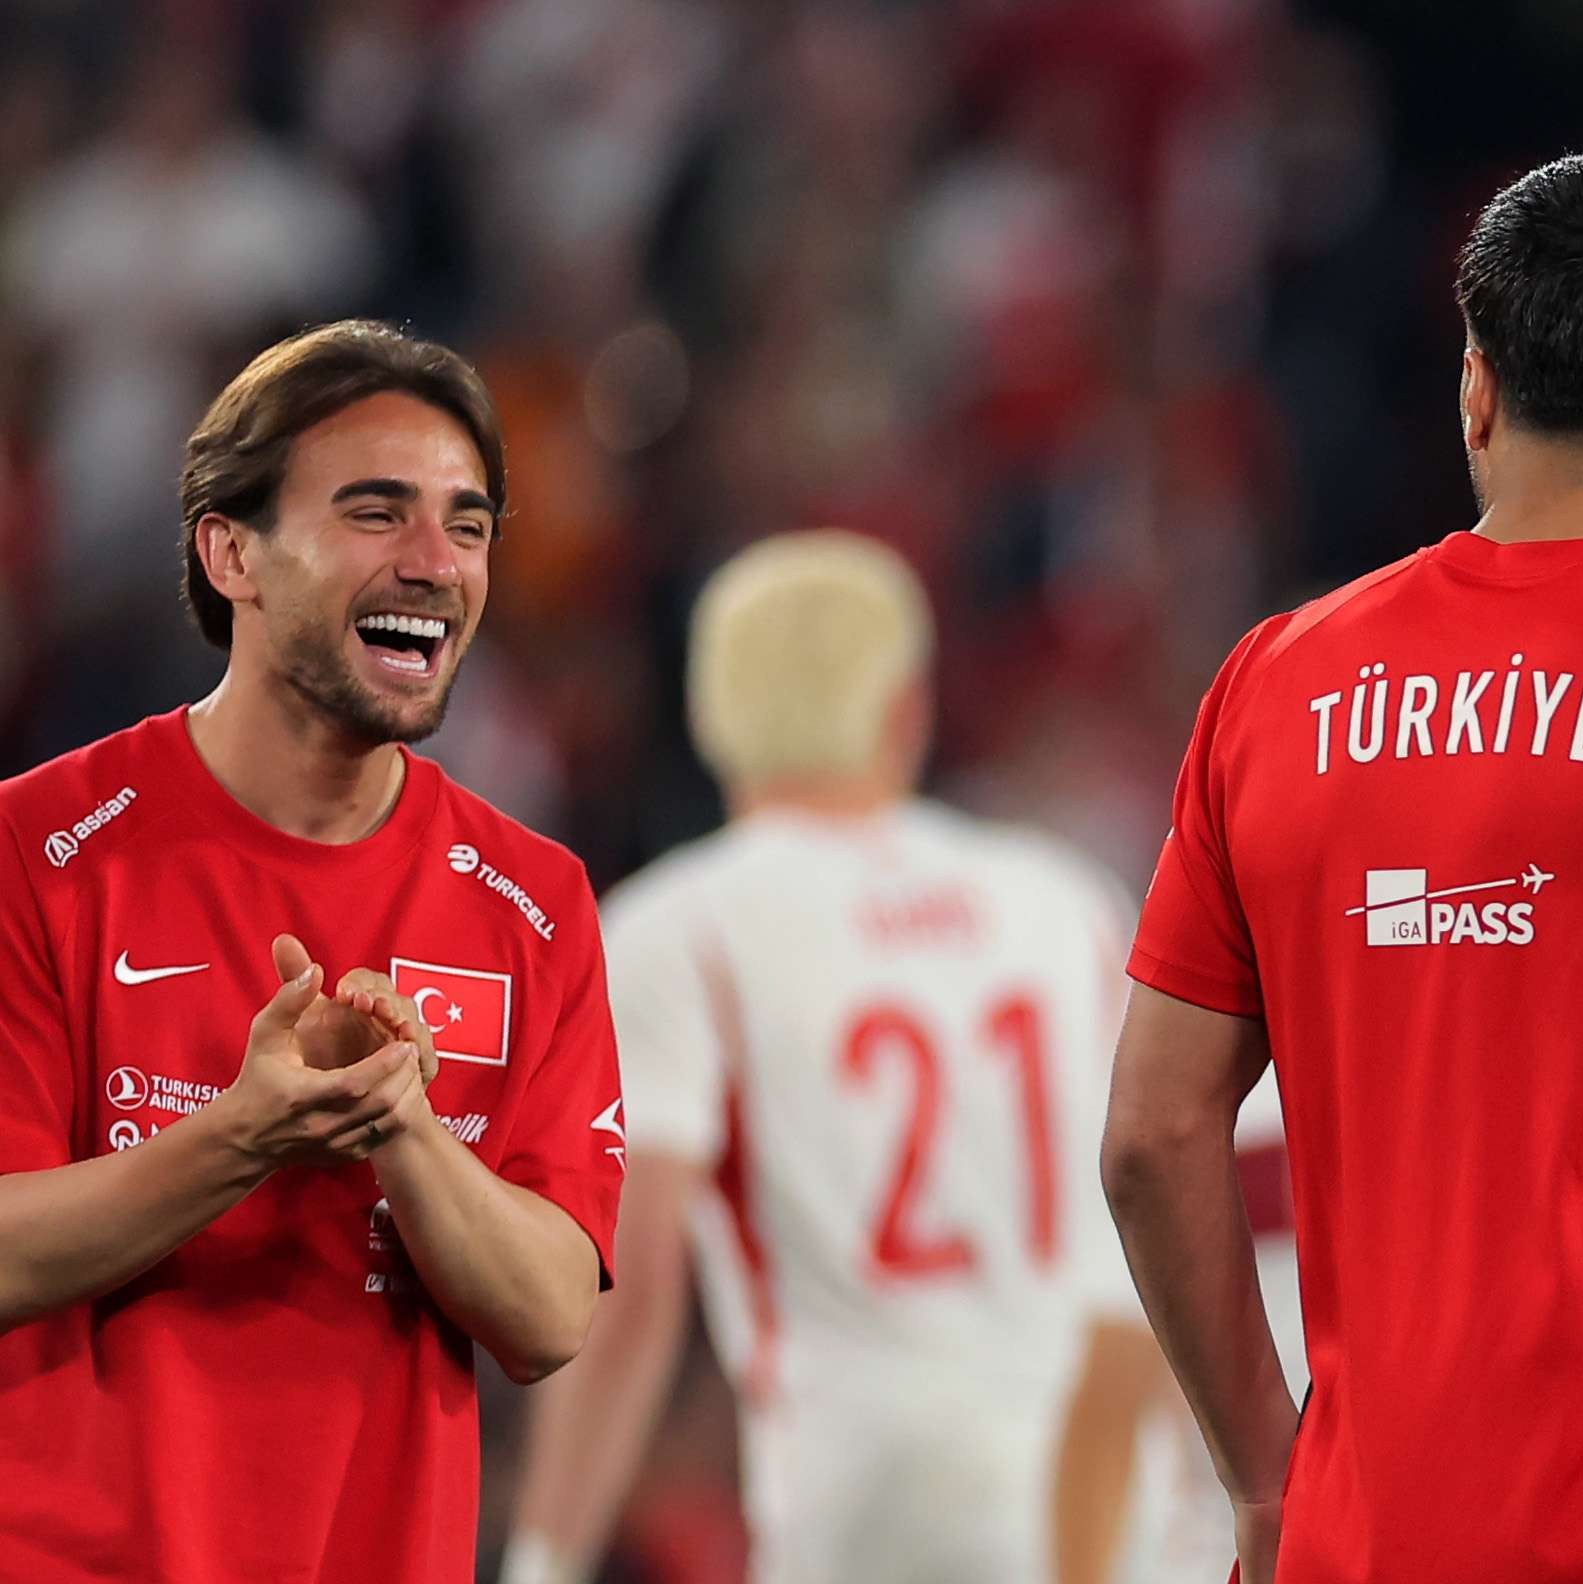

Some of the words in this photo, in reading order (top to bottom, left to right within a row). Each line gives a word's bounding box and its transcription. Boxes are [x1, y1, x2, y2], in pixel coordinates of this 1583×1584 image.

[477, 863, 556, 941] TURKCELL
[1431, 902, 1535, 945] PASS
[148, 1093, 208, 1115] AIRLIN
[836, 990, 1062, 1290] 21
